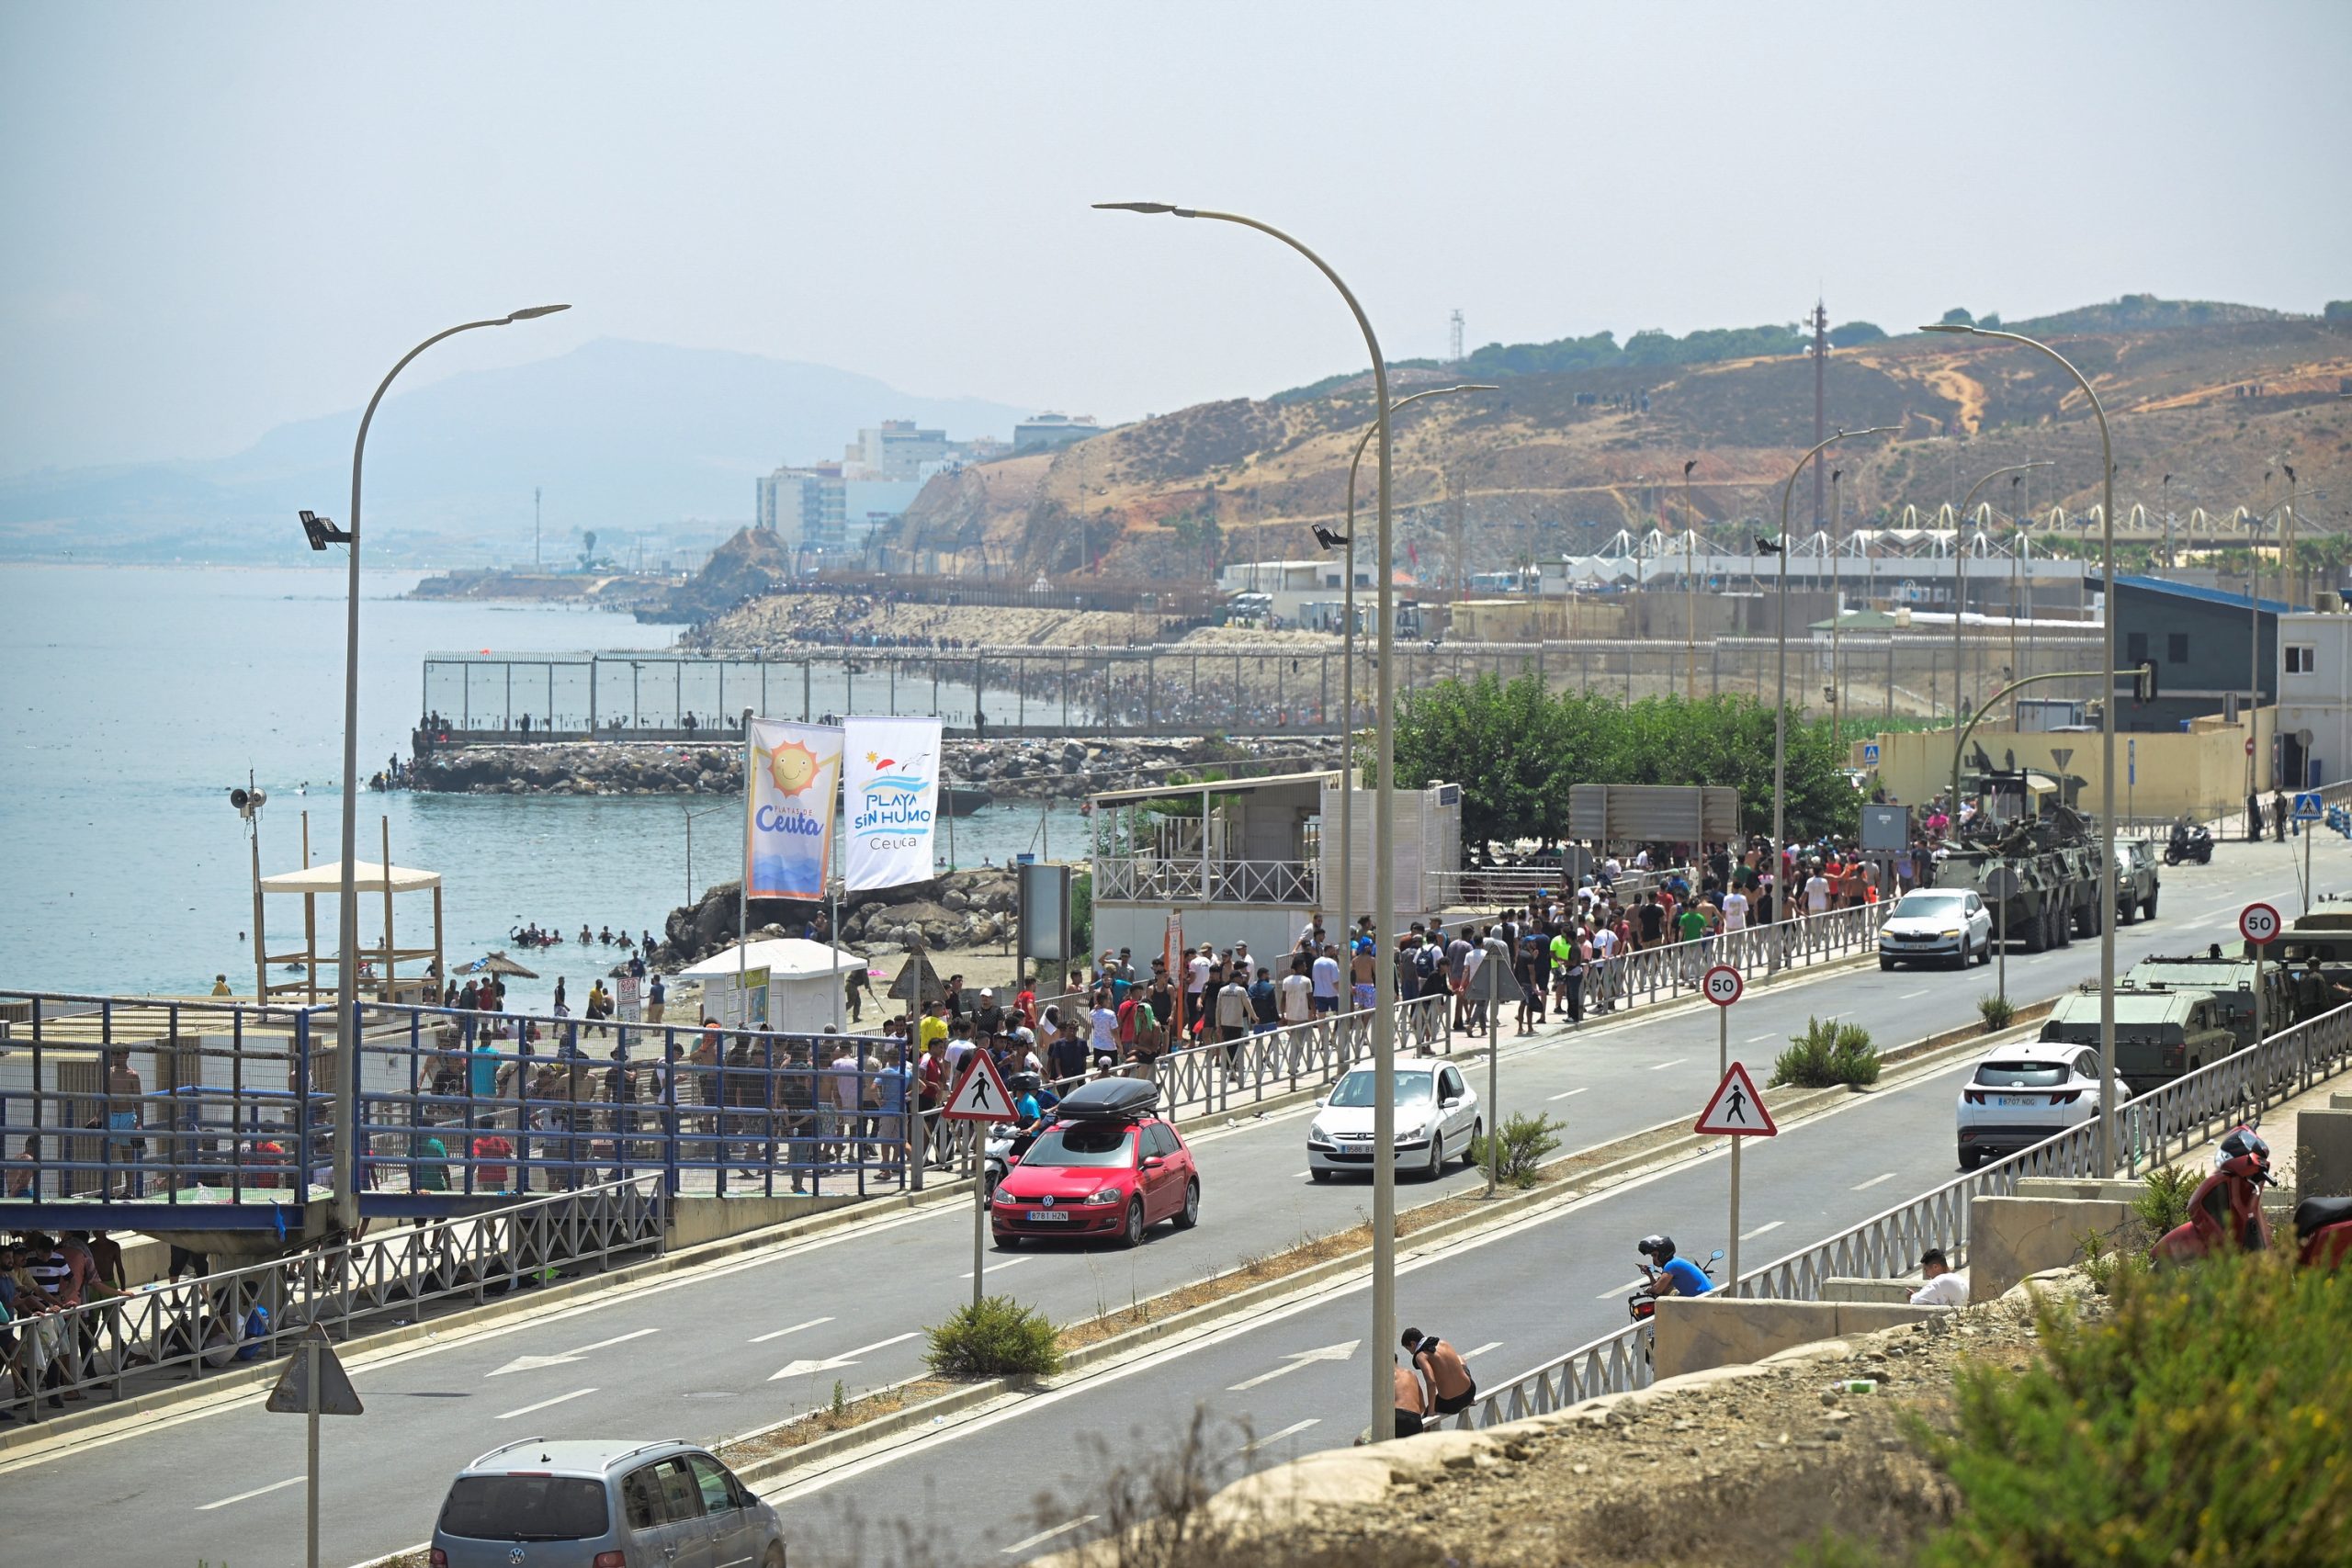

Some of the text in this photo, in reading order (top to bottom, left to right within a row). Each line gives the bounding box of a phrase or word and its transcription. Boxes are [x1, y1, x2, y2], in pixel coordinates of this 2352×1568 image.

[866, 794, 917, 811] PLAYA
[755, 805, 825, 837] Ceuta
[881, 809, 931, 825] HUMO
[2248, 917, 2271, 931] 50
[1712, 979, 1734, 992] 50
[1032, 1212, 1067, 1220] 8781 HZN
